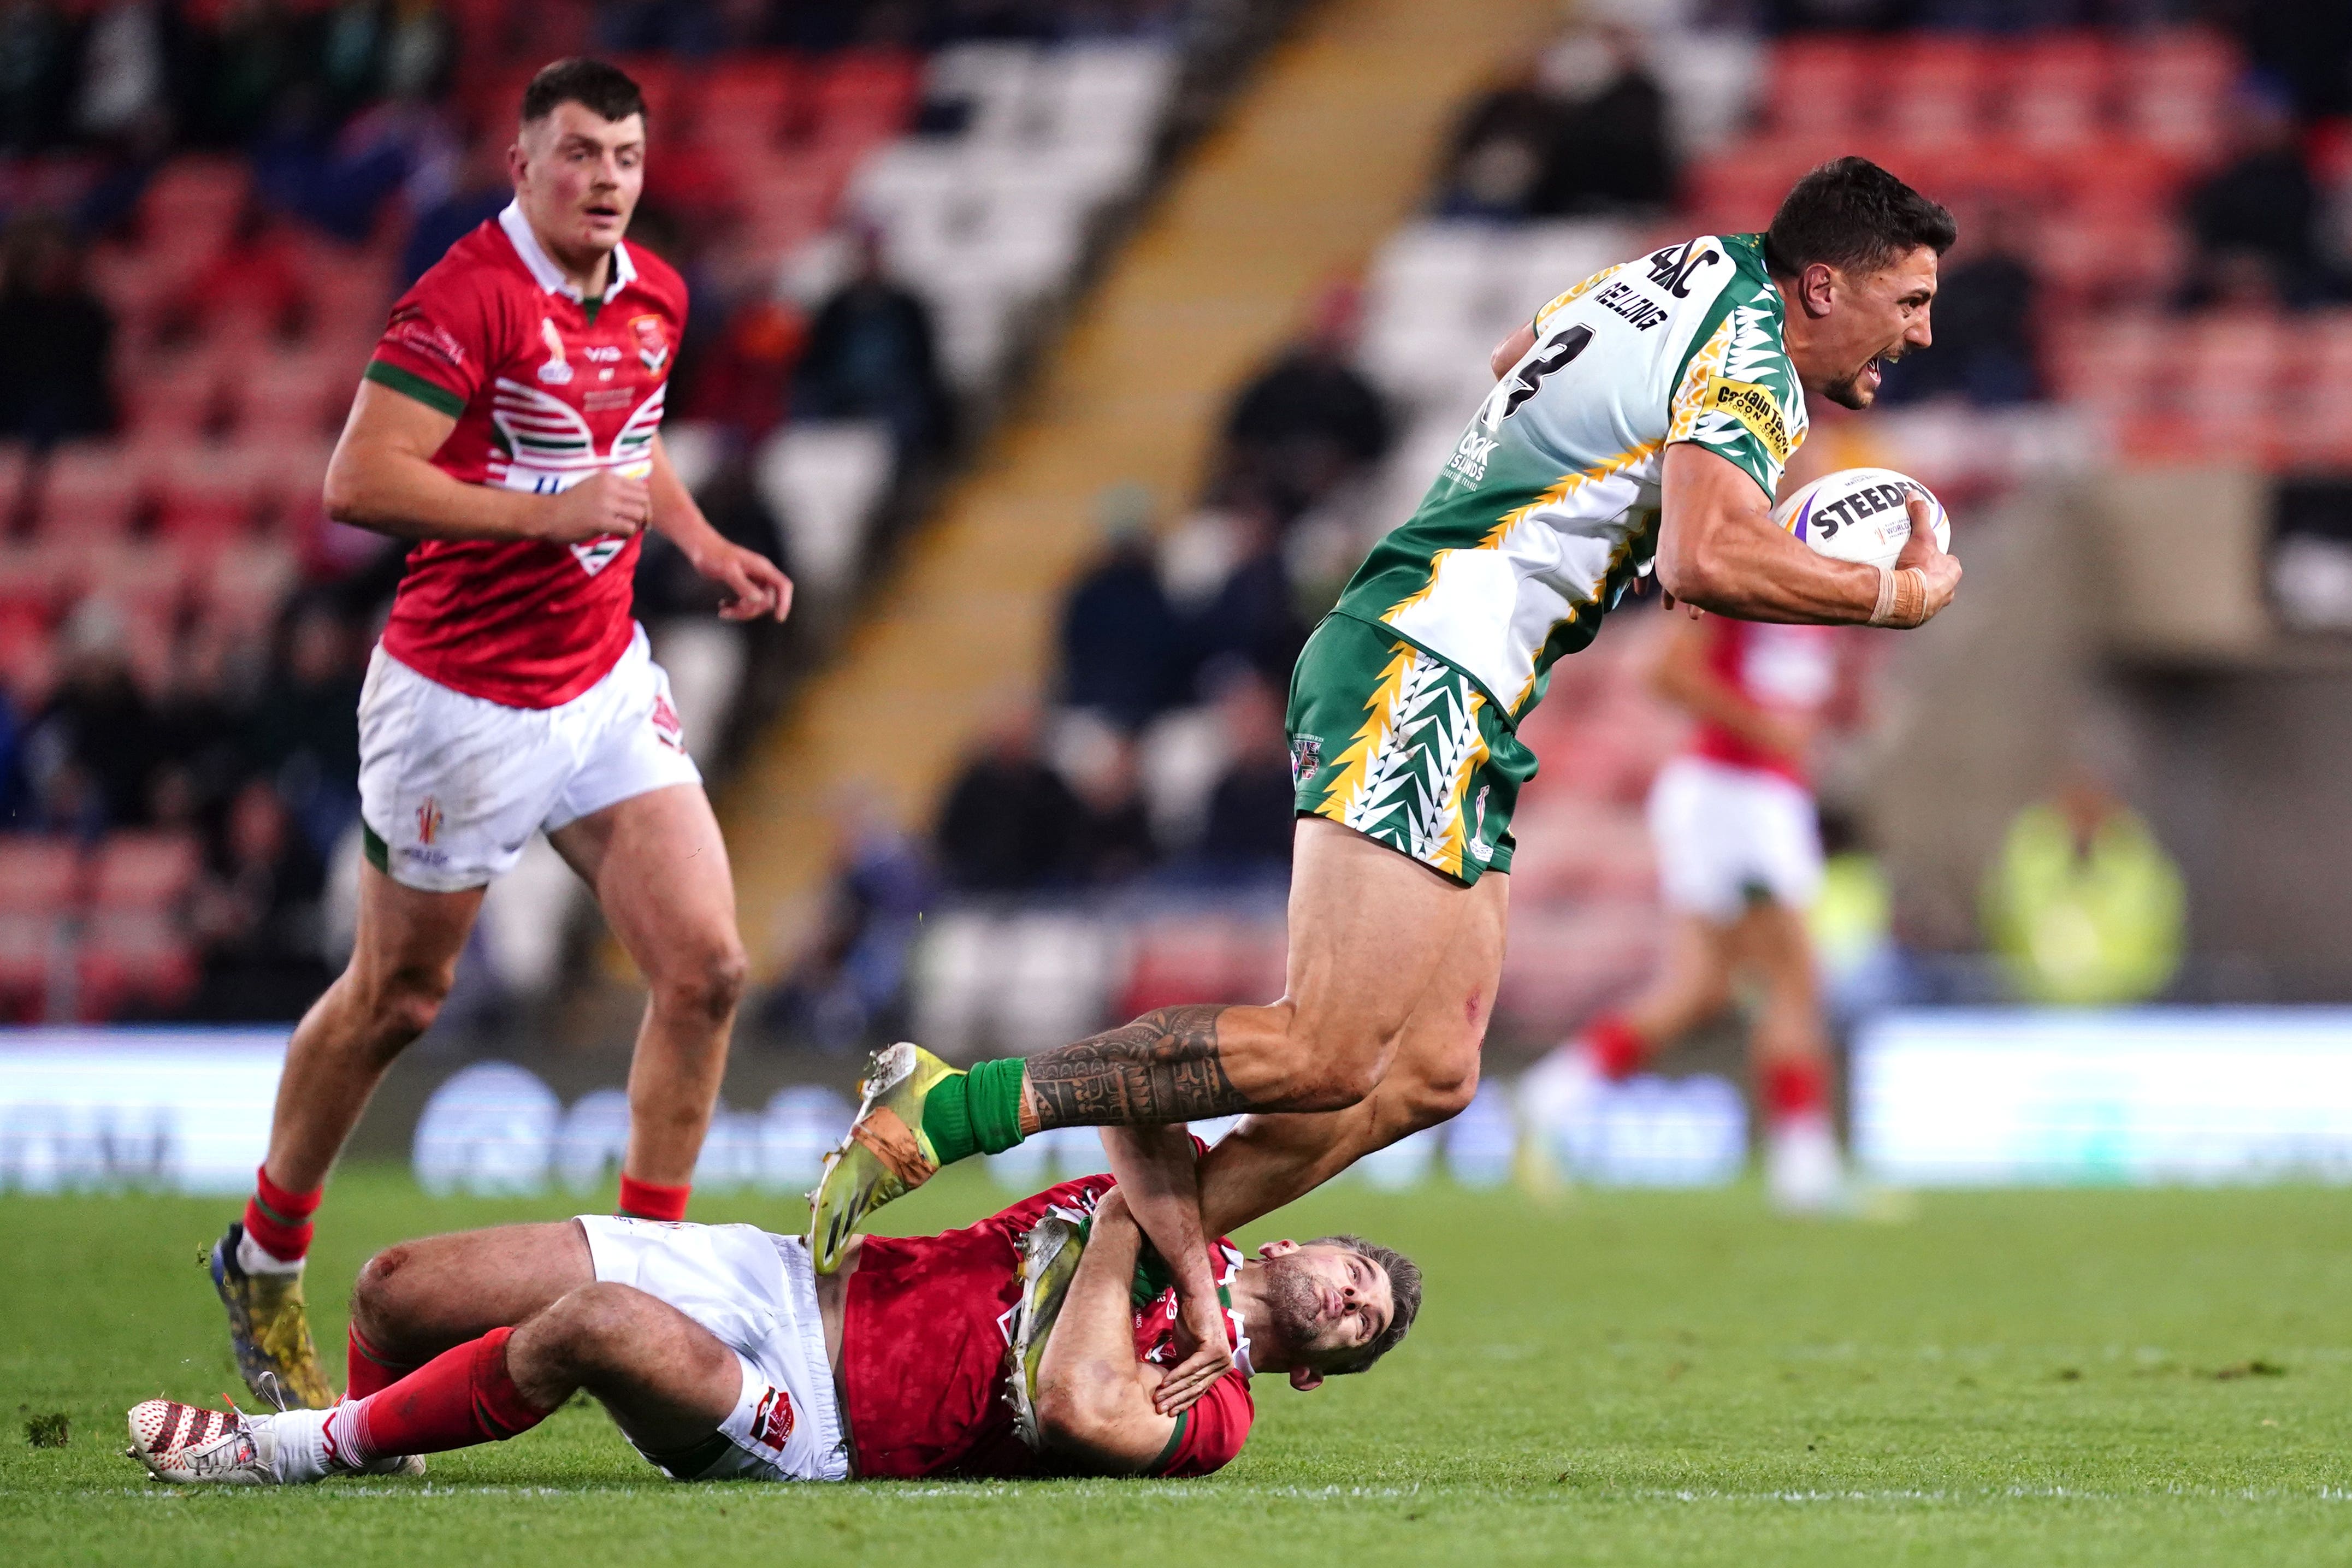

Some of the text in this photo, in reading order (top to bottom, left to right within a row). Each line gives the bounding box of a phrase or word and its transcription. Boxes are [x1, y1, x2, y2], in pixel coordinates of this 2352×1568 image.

[1594, 282, 1668, 332] GELLING
[1758, 424, 1773, 442] COOK
[1811, 481, 1935, 540] STEEDEN
[1886, 523, 1910, 535] WORLD
